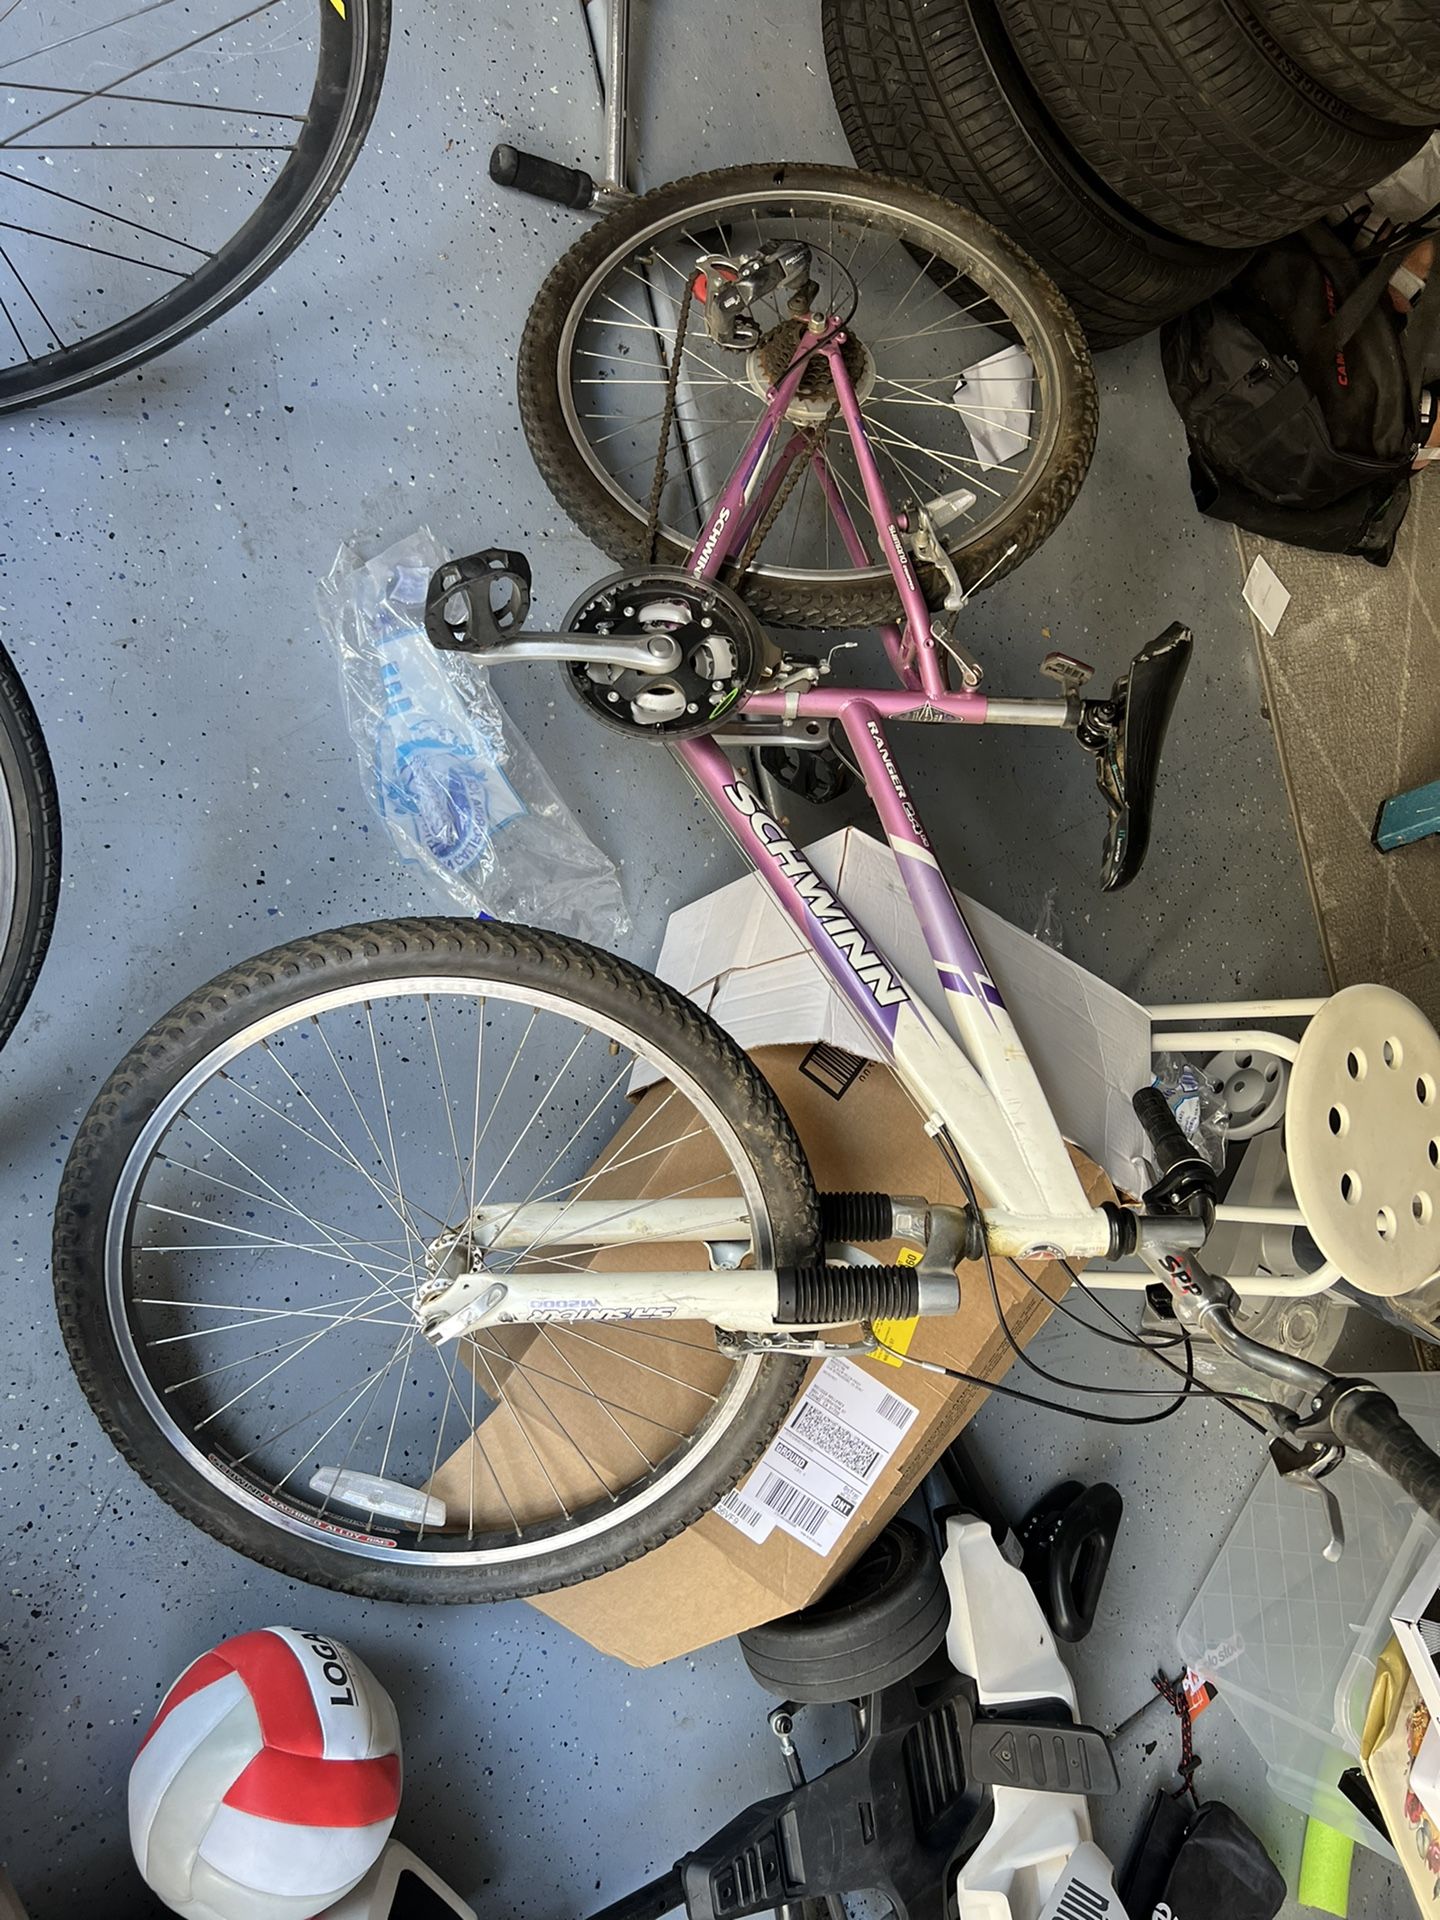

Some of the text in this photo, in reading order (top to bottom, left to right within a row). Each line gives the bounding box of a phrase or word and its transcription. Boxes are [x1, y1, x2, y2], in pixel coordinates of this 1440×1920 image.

[867, 720, 907, 798] RANGER
[723, 779, 911, 1007] SCHWINN
[904, 1253, 917, 1269] 60
[528, 1308, 630, 1321] SUNTOUR
[774, 1442, 808, 1470] GROUND
[831, 1494, 855, 1516] ONT
